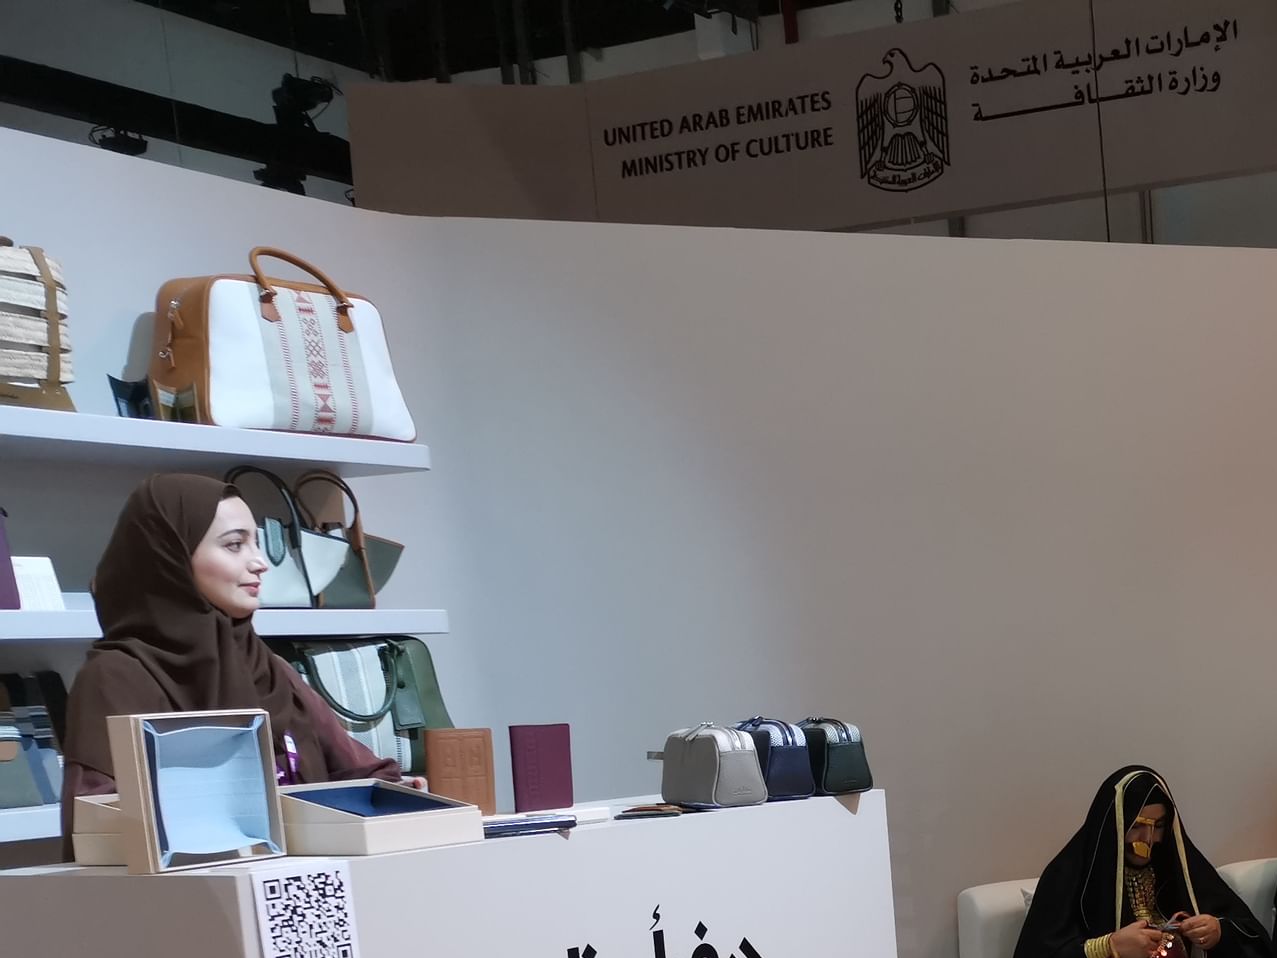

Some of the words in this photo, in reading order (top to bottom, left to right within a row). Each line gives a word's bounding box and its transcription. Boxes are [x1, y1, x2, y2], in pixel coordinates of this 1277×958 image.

[1053, 36, 1140, 75] العربية
[1145, 19, 1238, 57] الإمارات
[969, 53, 1048, 85] المتحدة
[1168, 65, 1222, 96] وزارة
[603, 118, 673, 147] UNITED
[679, 108, 731, 135] ARAB
[736, 90, 832, 125] EMIRATES
[621, 147, 709, 179] MINISTRY
[714, 142, 741, 164] OF
[745, 127, 834, 159] CULTURE
